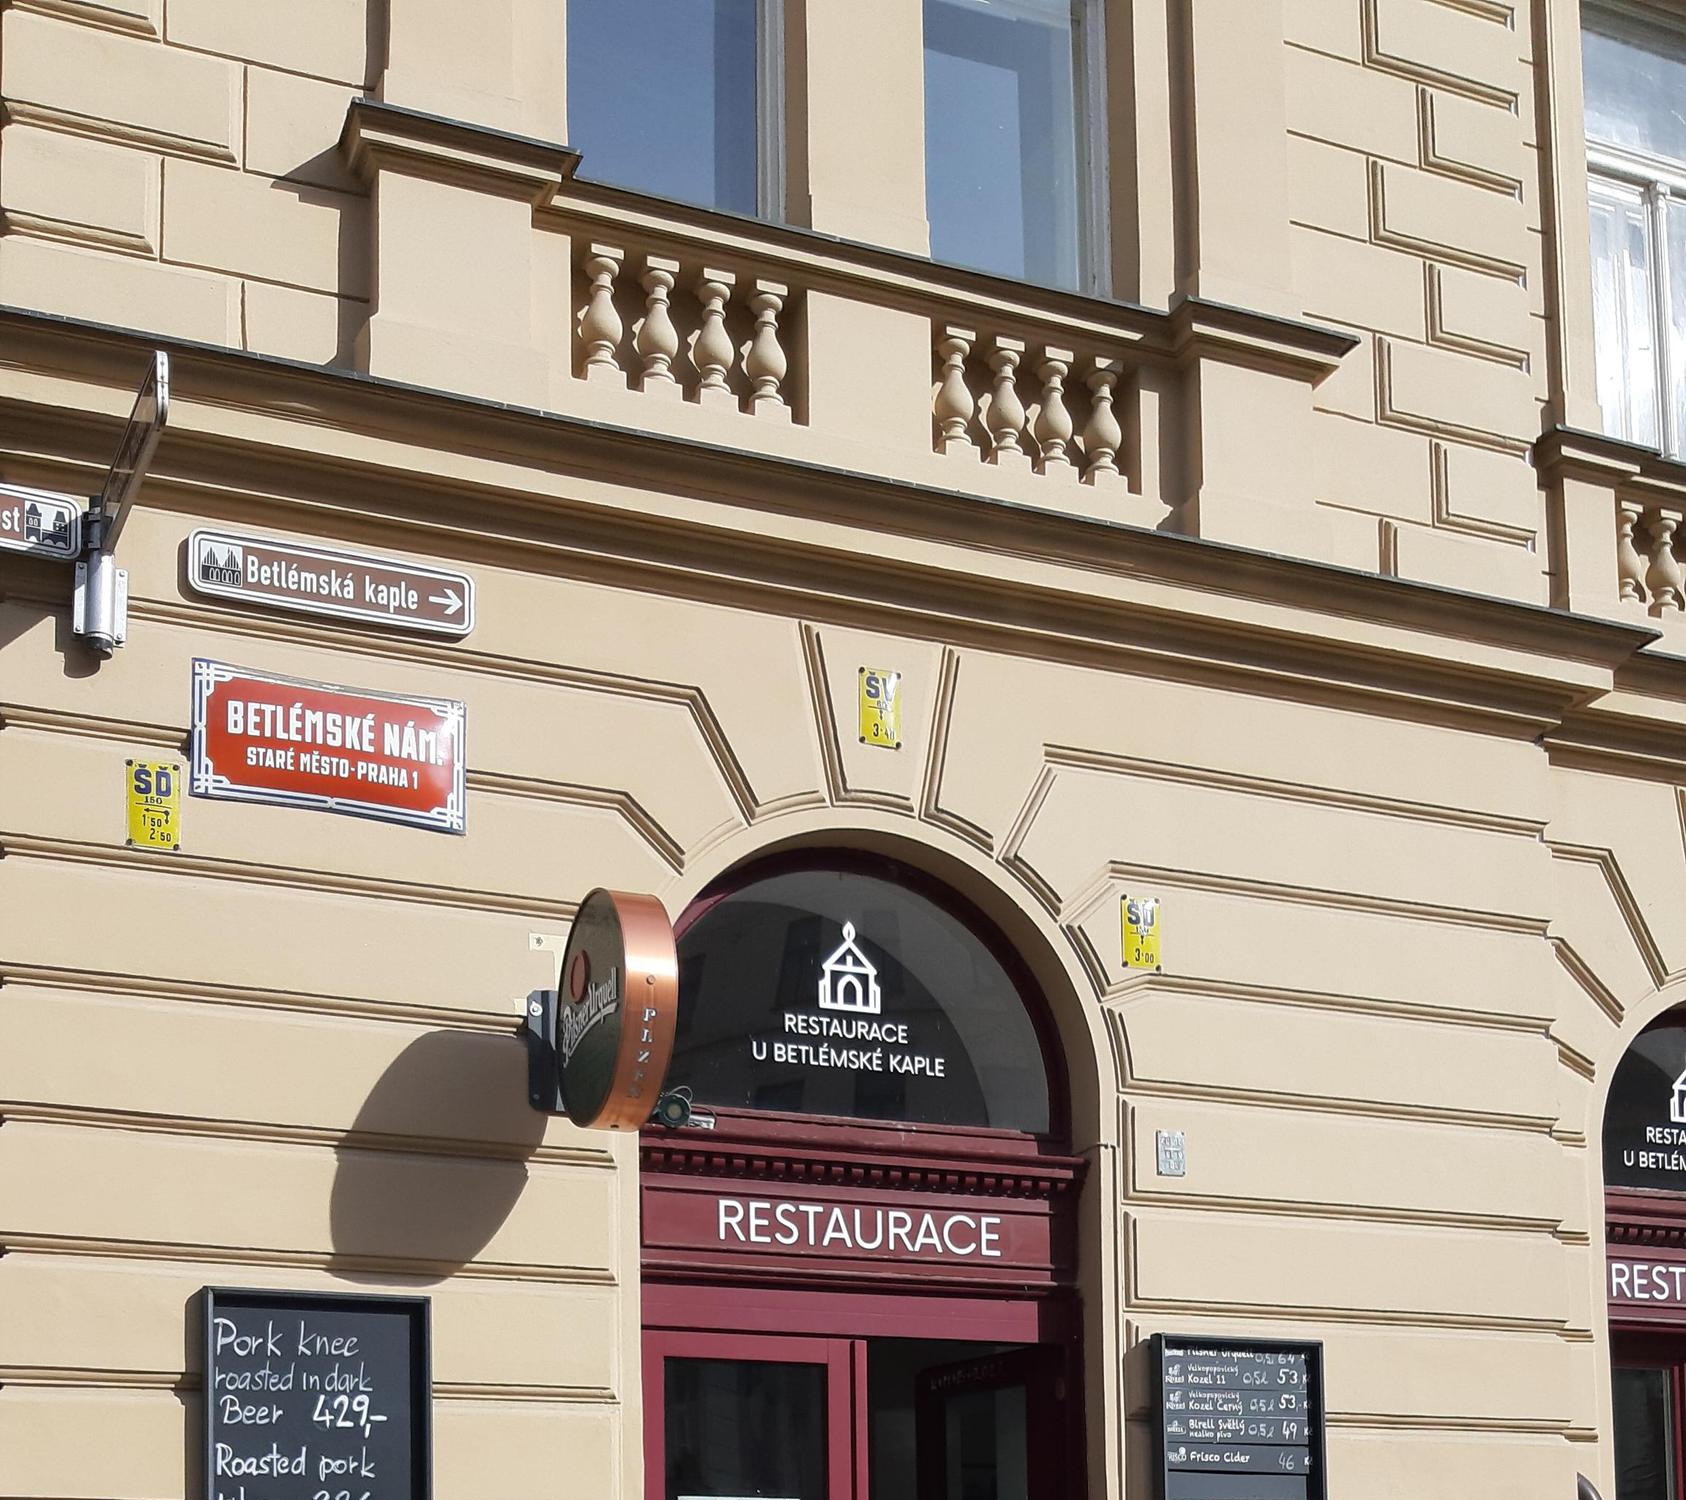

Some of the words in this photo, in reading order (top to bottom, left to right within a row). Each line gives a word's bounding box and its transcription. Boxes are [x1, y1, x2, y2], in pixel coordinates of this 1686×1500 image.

[247, 555, 354, 599] Betlémská
[365, 575, 418, 613] kaple
[227, 700, 376, 753] BETLÉMSKÉ
[383, 721, 444, 766] NÁM.
[247, 746, 295, 771] STARÉ
[412, 771, 418, 790] 1
[144, 796, 162, 804] 150
[784, 1013, 908, 1044] RESTAURACE
[752, 1041, 767, 1060] U
[774, 1042, 883, 1072] BETLÉMSKÉ
[889, 1054, 945, 1077] KAPLE
[1624, 1150, 1634, 1166] U
[718, 1200, 1002, 1257] RESTAURACE
[1612, 1263, 1686, 1300] REST
[214, 1318, 283, 1357] Pork
[298, 1320, 359, 1357] knee
[215, 1360, 294, 1392] roasted
[303, 1371, 319, 1391] in
[325, 1362, 373, 1392] dark
[1188, 1373, 1213, 1384] Kozel
[220, 1395, 283, 1425] Beer
[1188, 1399, 1214, 1411] Kozel
[216, 1442, 306, 1478] Roasted
[320, 1446, 375, 1481] pork
[1190, 1451, 1220, 1463] Frisco
[1223, 1451, 1250, 1463] Cider
